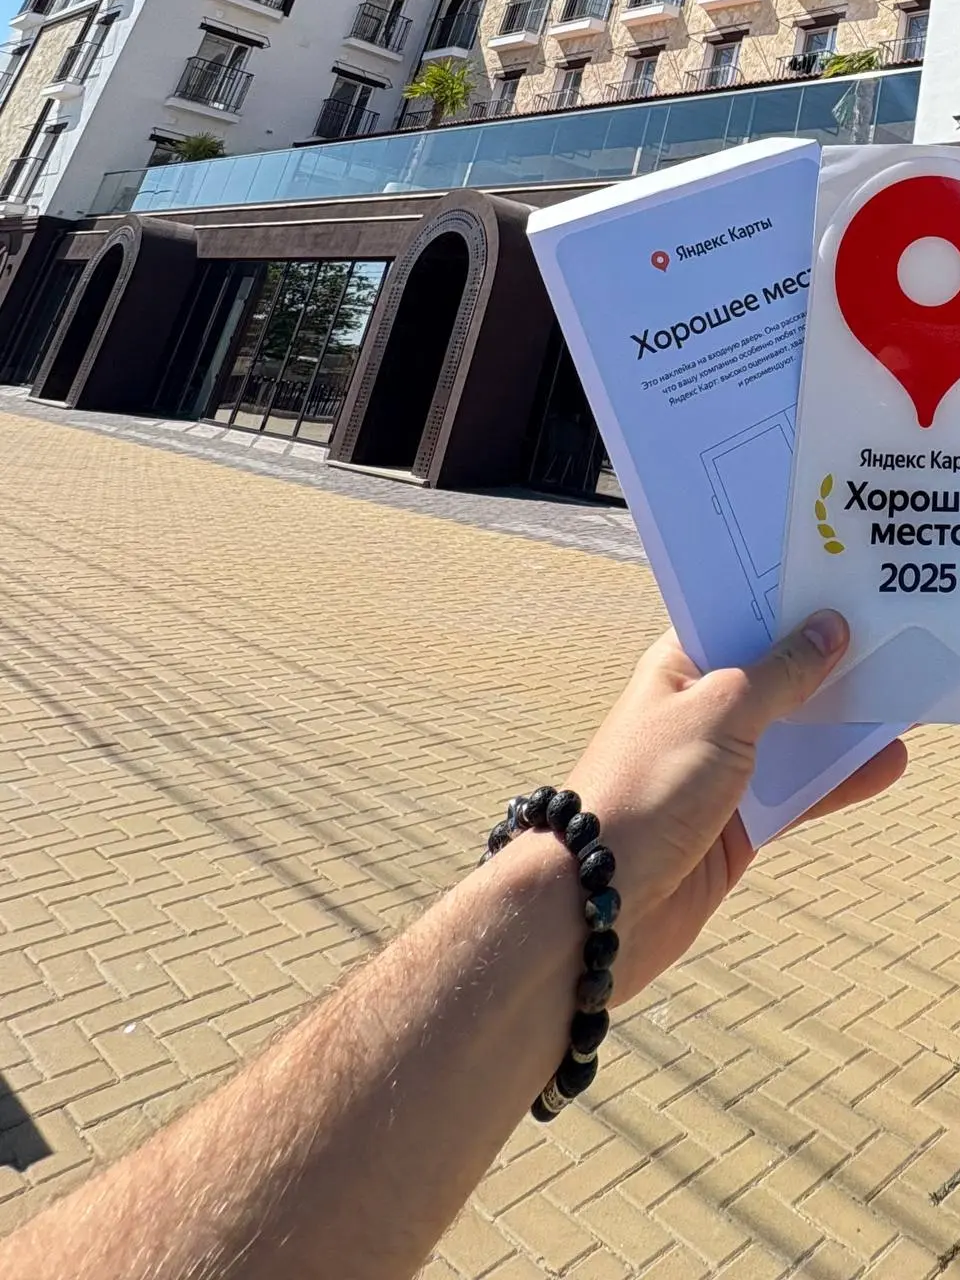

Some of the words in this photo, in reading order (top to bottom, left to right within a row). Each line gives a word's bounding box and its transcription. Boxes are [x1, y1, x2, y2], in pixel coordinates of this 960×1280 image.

[675, 233, 728, 261] Яндекс
[728, 217, 773, 243] Карты
[629, 293, 760, 360] Хорошее
[762, 268, 812, 305] мес
[641, 378, 659, 391] Это
[659, 361, 696, 383] наклейка
[697, 356, 707, 366] на
[707, 342, 740, 361] входную
[764, 323, 780, 335] Она
[662, 384, 677, 394] что
[677, 374, 698, 388] вашу
[699, 355, 738, 379] компанию
[738, 340, 774, 360] особенно
[774, 328, 797, 344] любят
[738, 380, 744, 388] и
[744, 355, 796, 386] рекомендуют.
[668, 388, 698, 406] Яндекс
[720, 365, 747, 382] высоко
[860, 448, 926, 471] Яндекс
[878, 562, 957, 593] 2025
